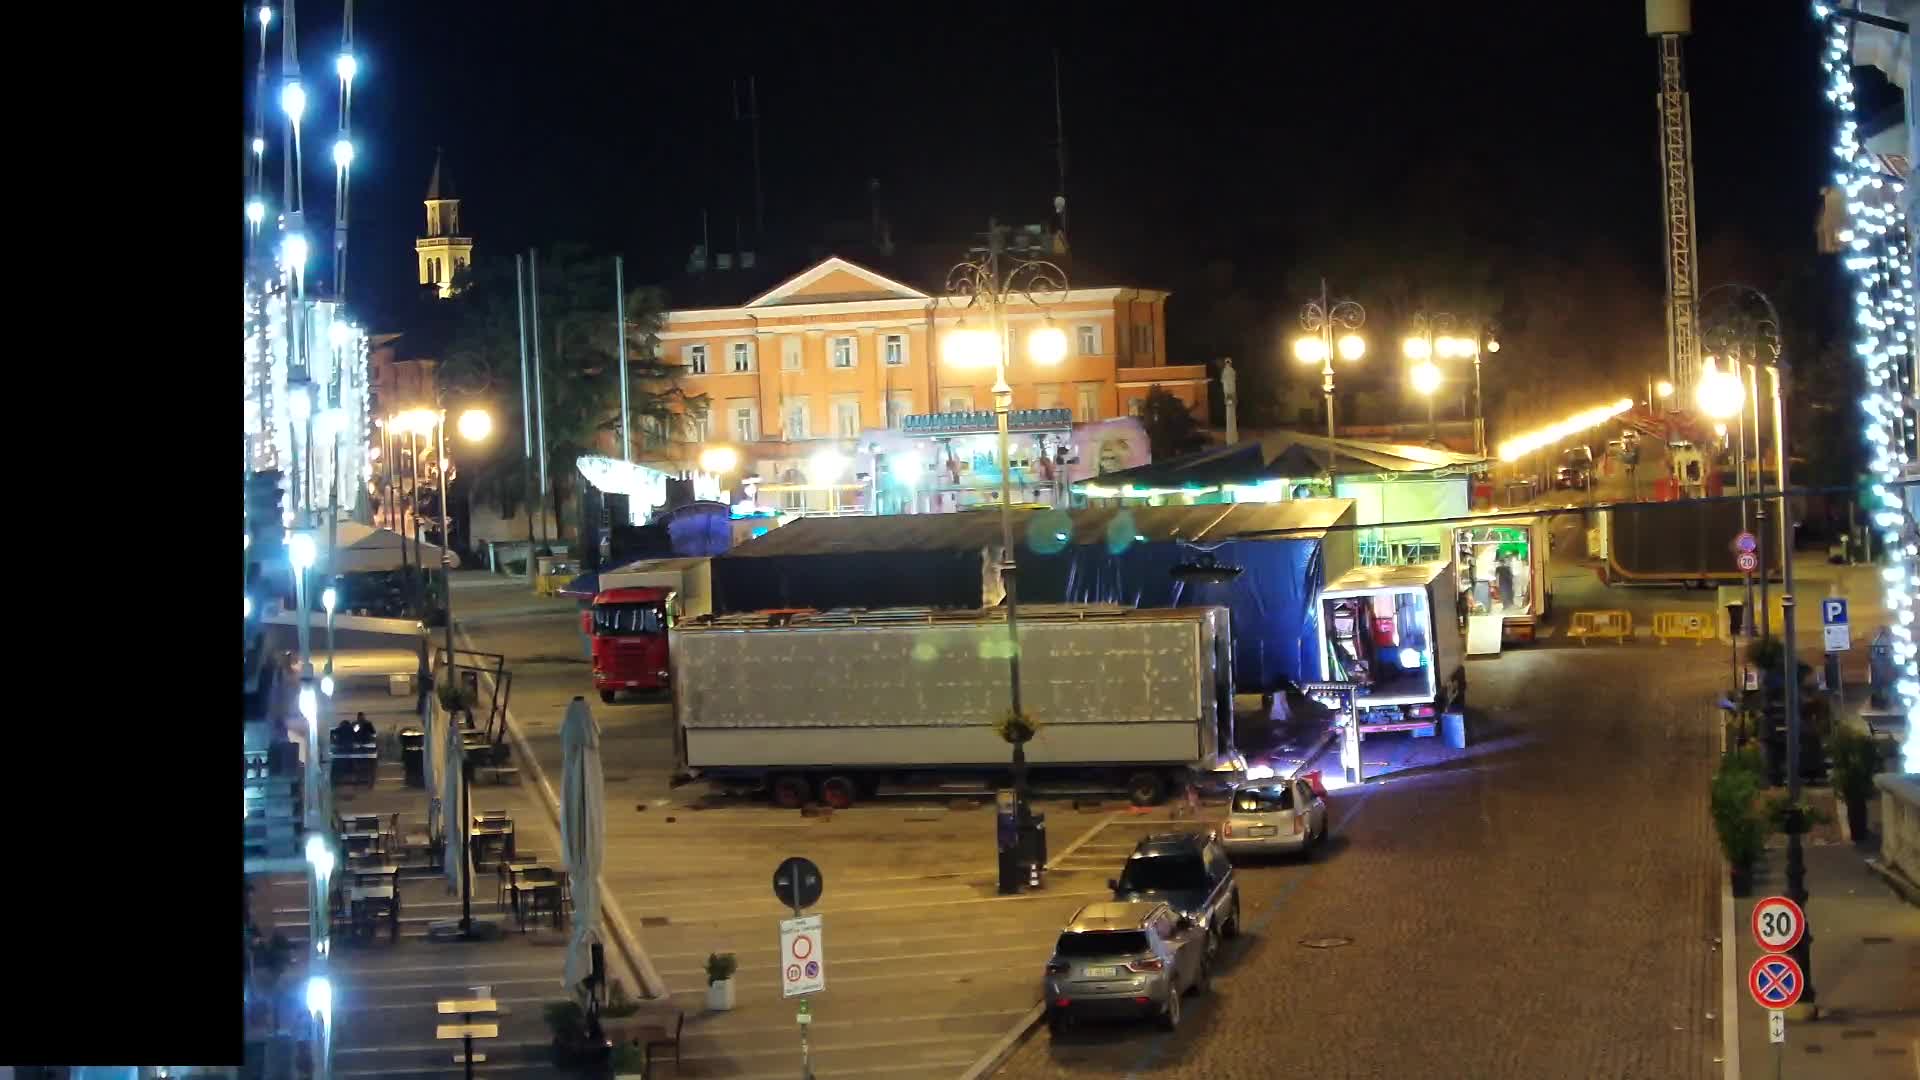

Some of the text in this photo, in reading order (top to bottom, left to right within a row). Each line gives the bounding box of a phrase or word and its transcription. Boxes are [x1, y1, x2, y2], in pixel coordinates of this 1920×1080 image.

[1742, 558, 1753, 567] 20
[1827, 602, 1842, 622] P
[1762, 912, 1791, 937] 30
